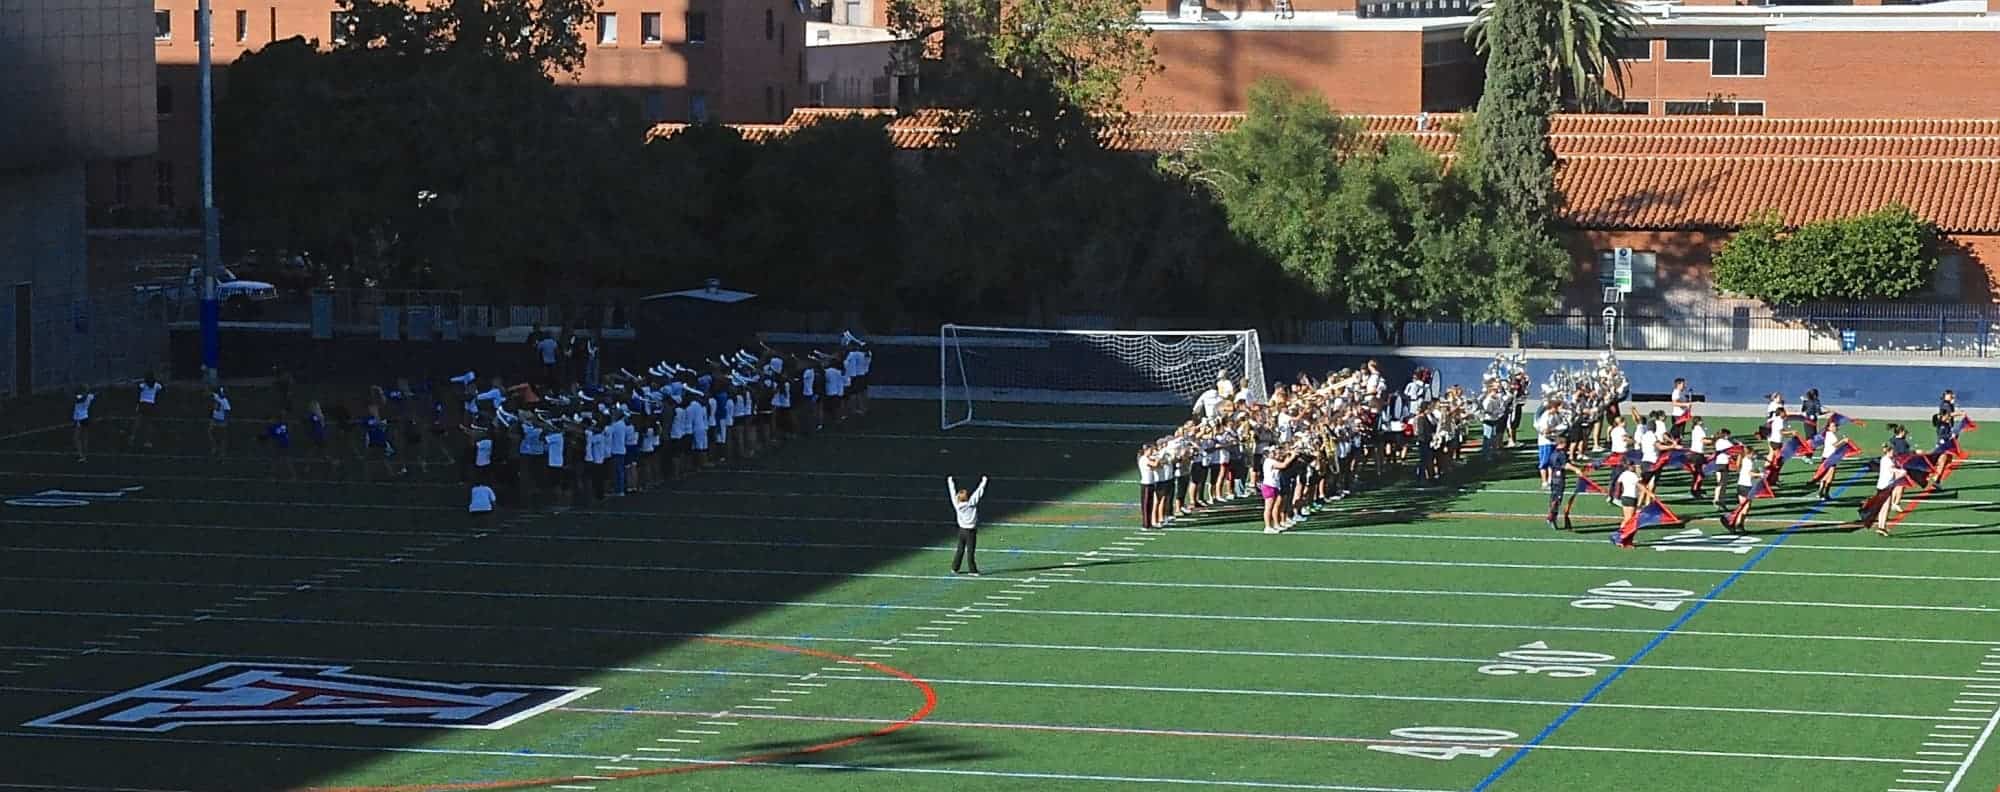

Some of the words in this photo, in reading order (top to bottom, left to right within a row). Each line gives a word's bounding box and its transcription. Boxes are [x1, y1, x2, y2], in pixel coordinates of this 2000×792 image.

[1570, 587, 1695, 611] 20
[1477, 650, 1616, 677] 30
[1367, 726, 1519, 760] 40
